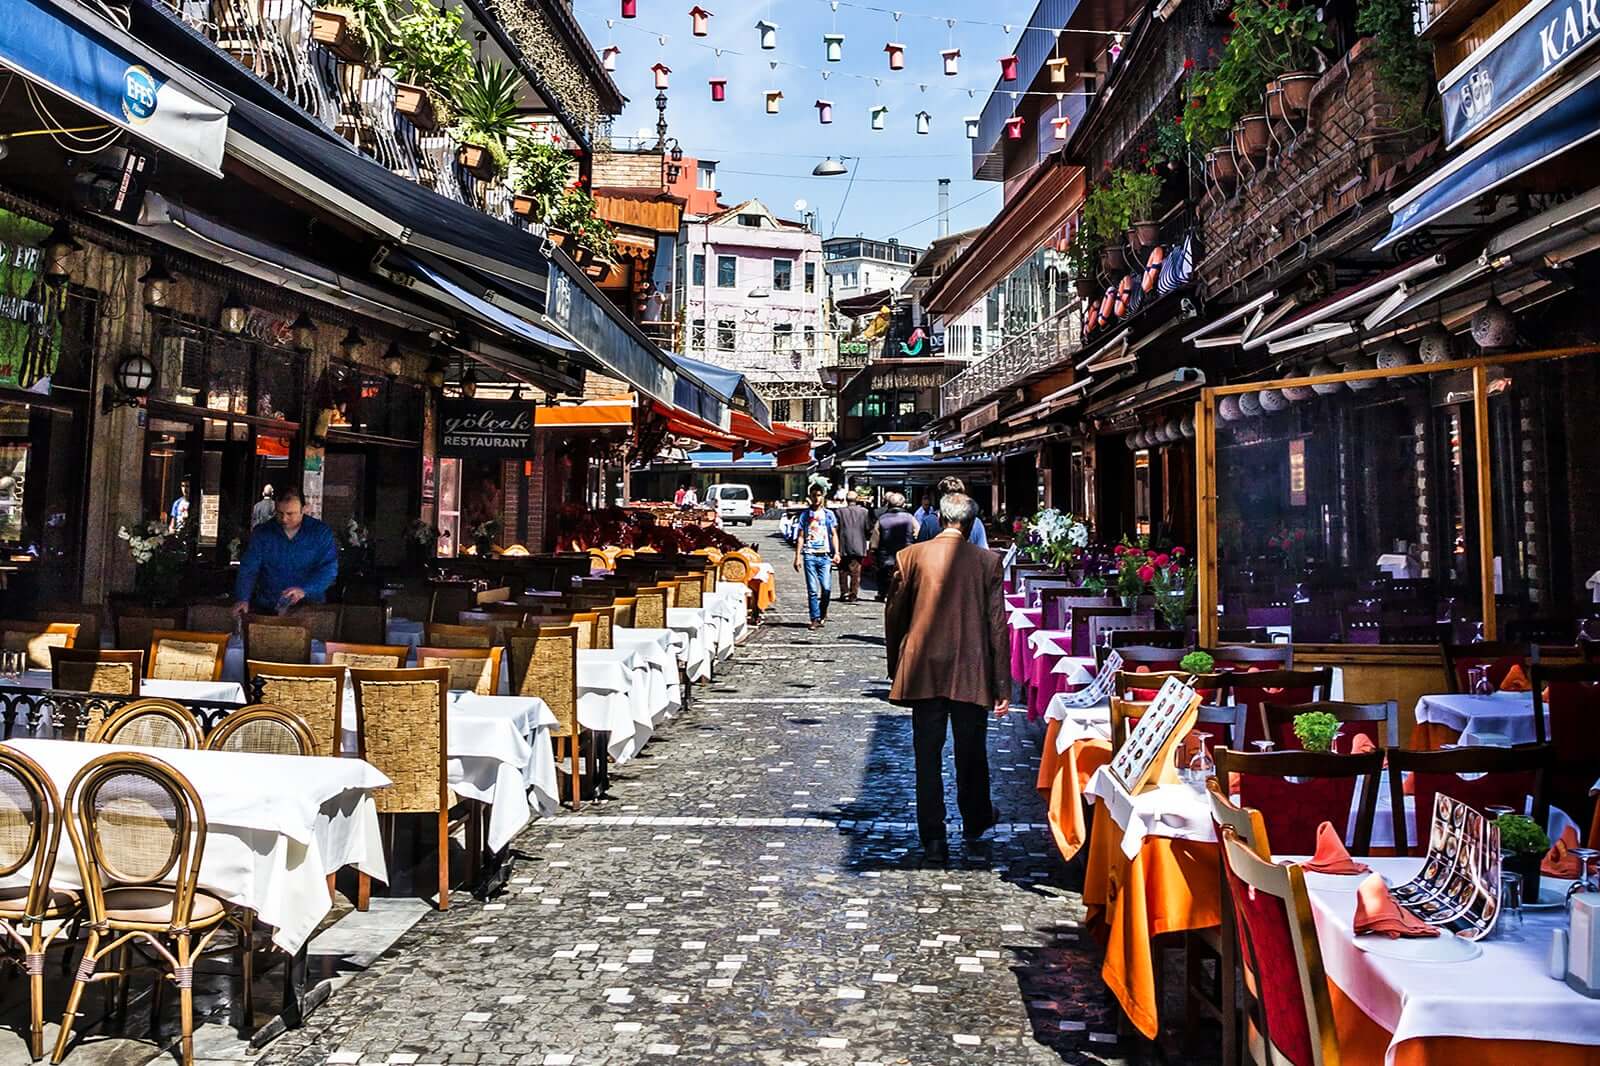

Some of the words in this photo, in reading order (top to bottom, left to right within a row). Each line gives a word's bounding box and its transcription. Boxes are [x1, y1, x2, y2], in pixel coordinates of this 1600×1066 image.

[126, 74, 153, 107] EFES
[444, 409, 531, 433] gölçek
[443, 436, 529, 448] RESTAURANT
